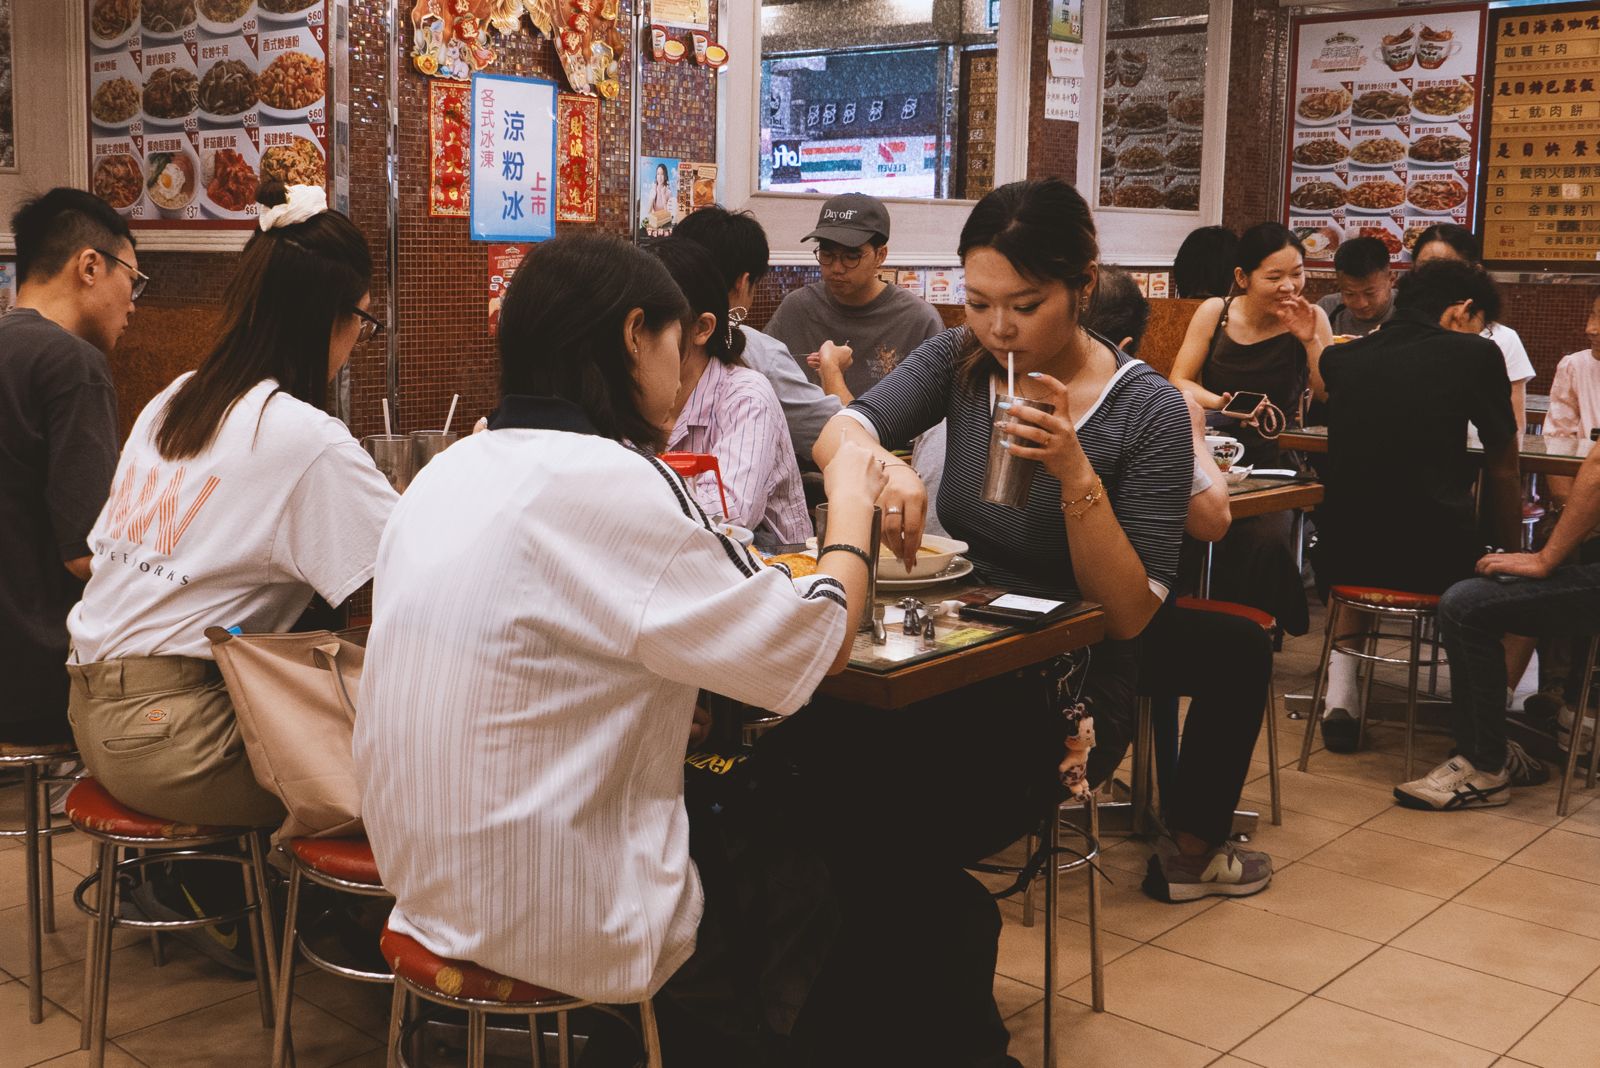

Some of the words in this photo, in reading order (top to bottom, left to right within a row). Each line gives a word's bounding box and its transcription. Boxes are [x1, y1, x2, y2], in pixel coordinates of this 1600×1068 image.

[308, 10, 322, 21] $60
[243, 20, 256, 31] $60
[183, 29, 196, 40] $65
[316, 28, 323, 41] 8
[250, 36, 257, 49] 7
[190, 44, 197, 57] 6
[1503, 43, 1568, 58] 咖喱牛肉
[135, 52, 141, 64] 5
[243, 113, 257, 123] $60
[308, 108, 323, 119] $60
[184, 118, 197, 128] $65
[251, 130, 259, 142] 11
[316, 125, 326, 138] 12
[137, 138, 143, 149] 9
[191, 134, 199, 145] 10
[501, 109, 526, 221] 涼粉冰
[1496, 169, 1505, 179] A
[530, 171, 547, 216] 上市
[1495, 187, 1504, 197] B
[132, 206, 144, 216] $62
[187, 205, 198, 218] $37
[245, 205, 258, 215] $61
[1493, 205, 1503, 215] C
